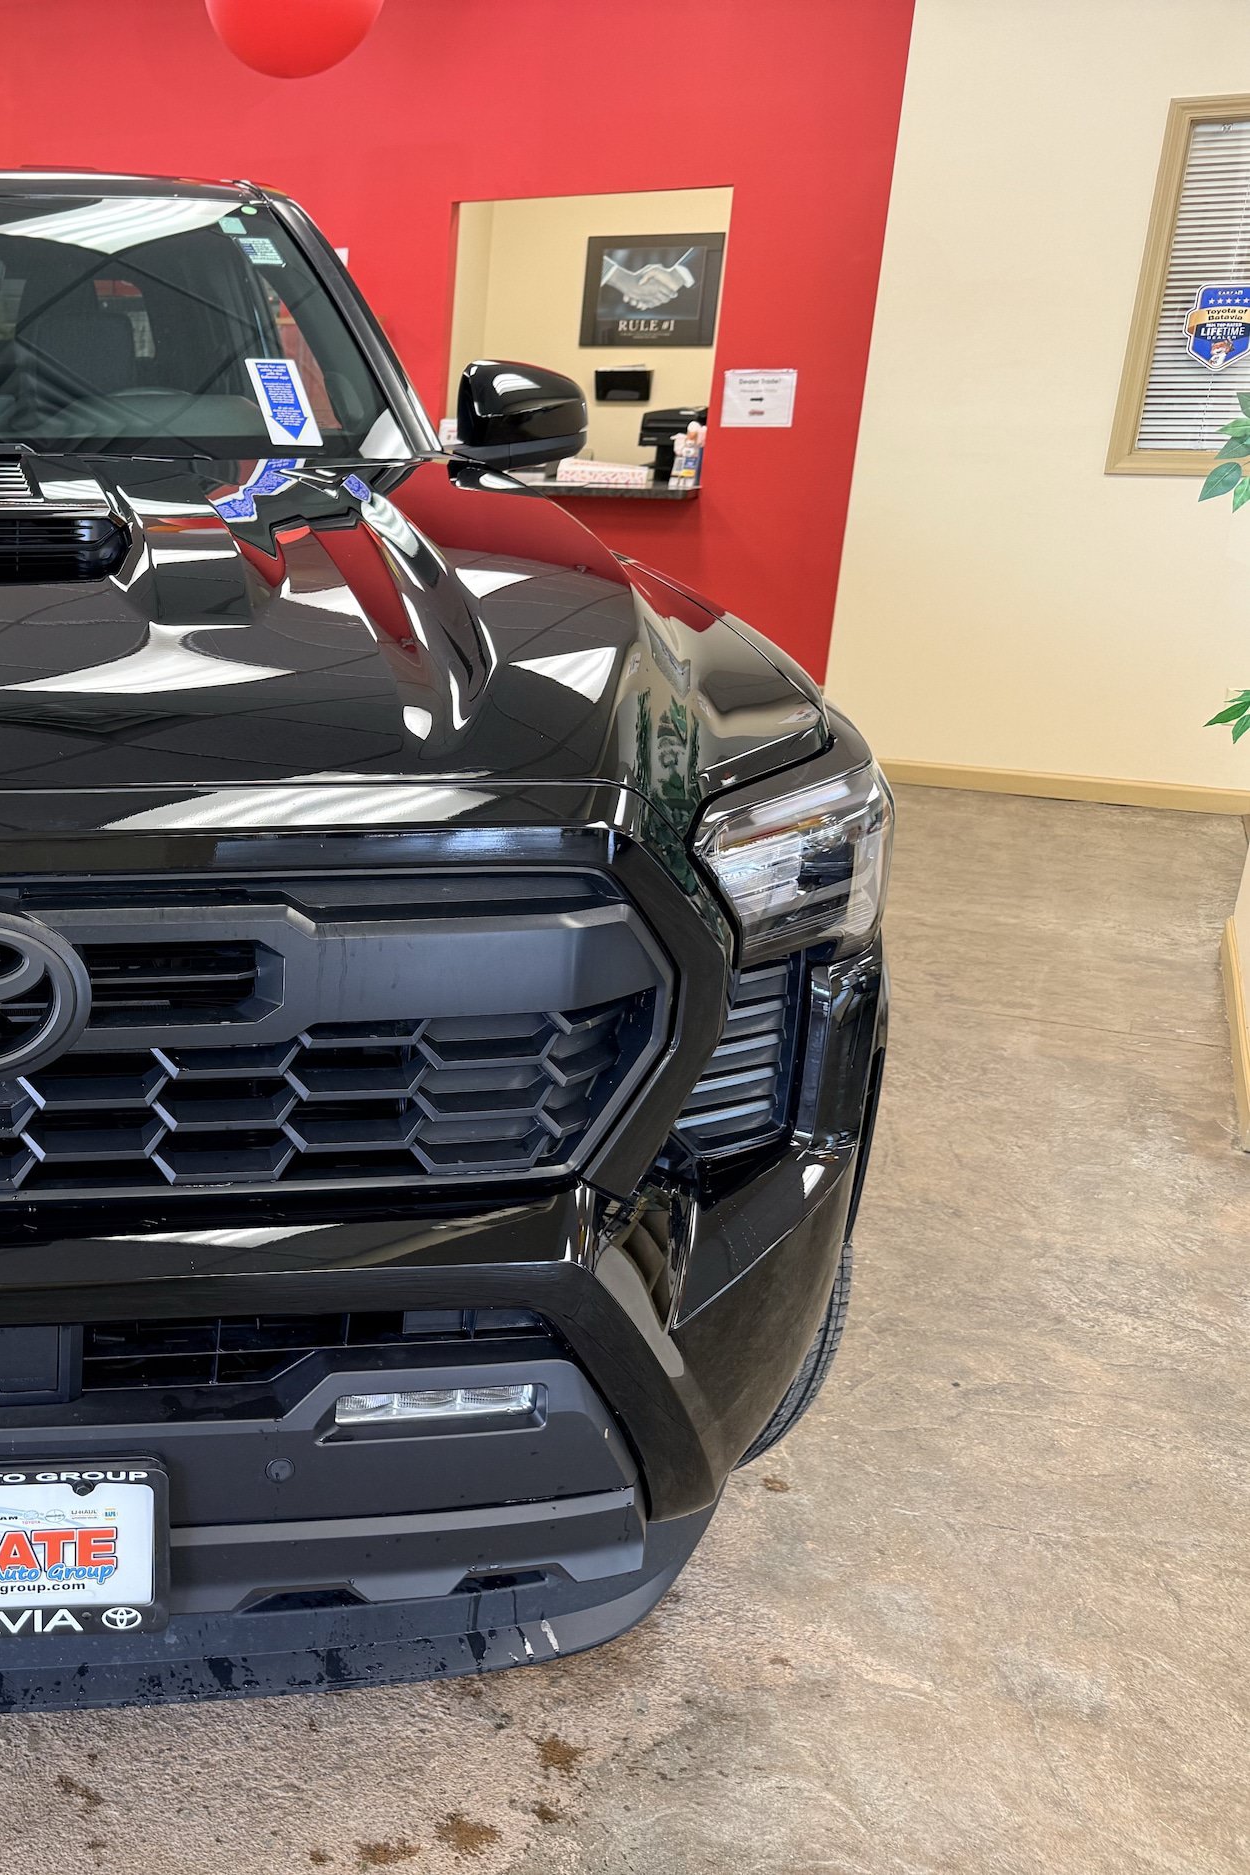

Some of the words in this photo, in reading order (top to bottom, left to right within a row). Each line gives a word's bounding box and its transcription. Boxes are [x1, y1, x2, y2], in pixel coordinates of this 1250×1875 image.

[618, 319, 659, 332] RULE
[661, 319, 675, 331] #1
[1200, 327, 1245, 336] LIFETIME
[35, 1471, 148, 1483] GROUP
[47, 1562, 115, 1585] Group
